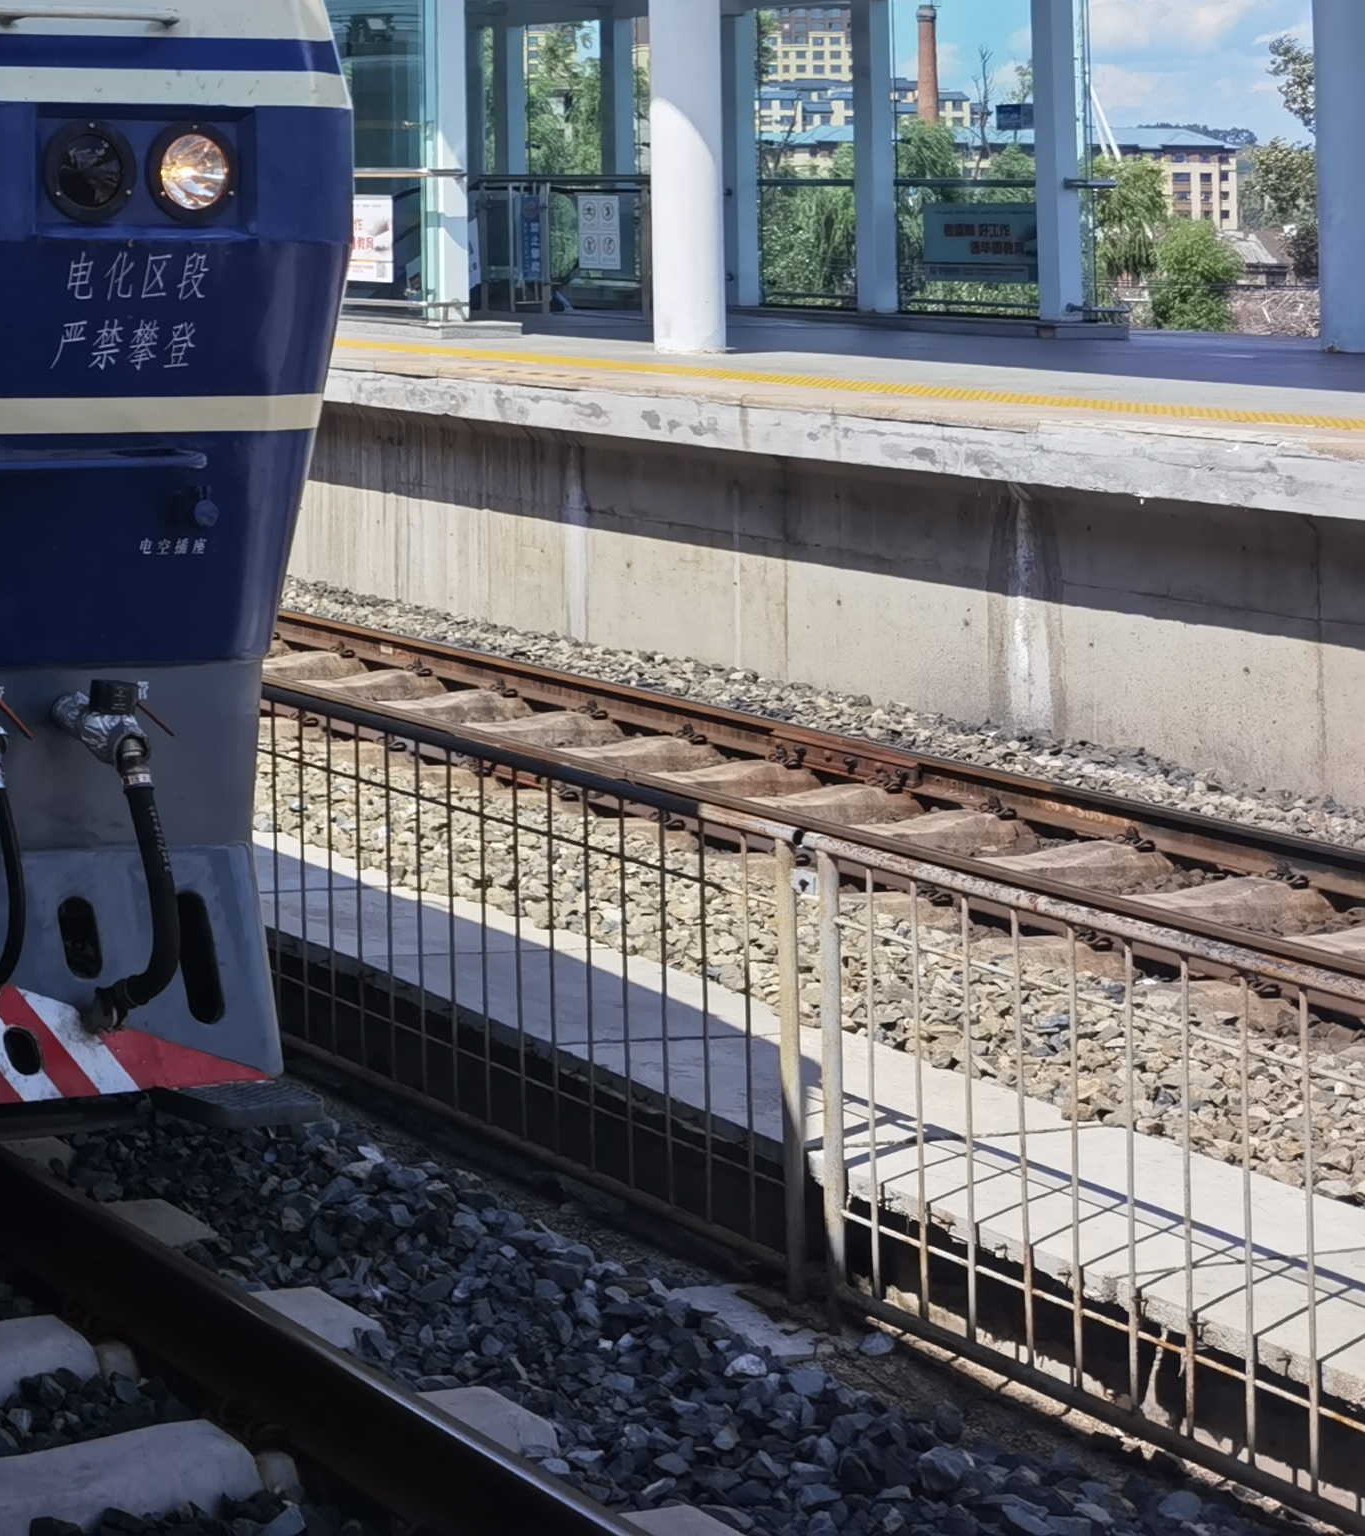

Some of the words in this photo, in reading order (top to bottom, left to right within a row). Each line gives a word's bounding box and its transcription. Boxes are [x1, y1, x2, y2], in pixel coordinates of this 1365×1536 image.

[67, 251, 209, 301] 电化区段
[49, 318, 197, 370] 严禁攀登
[139, 537, 207, 555] 电空插座
